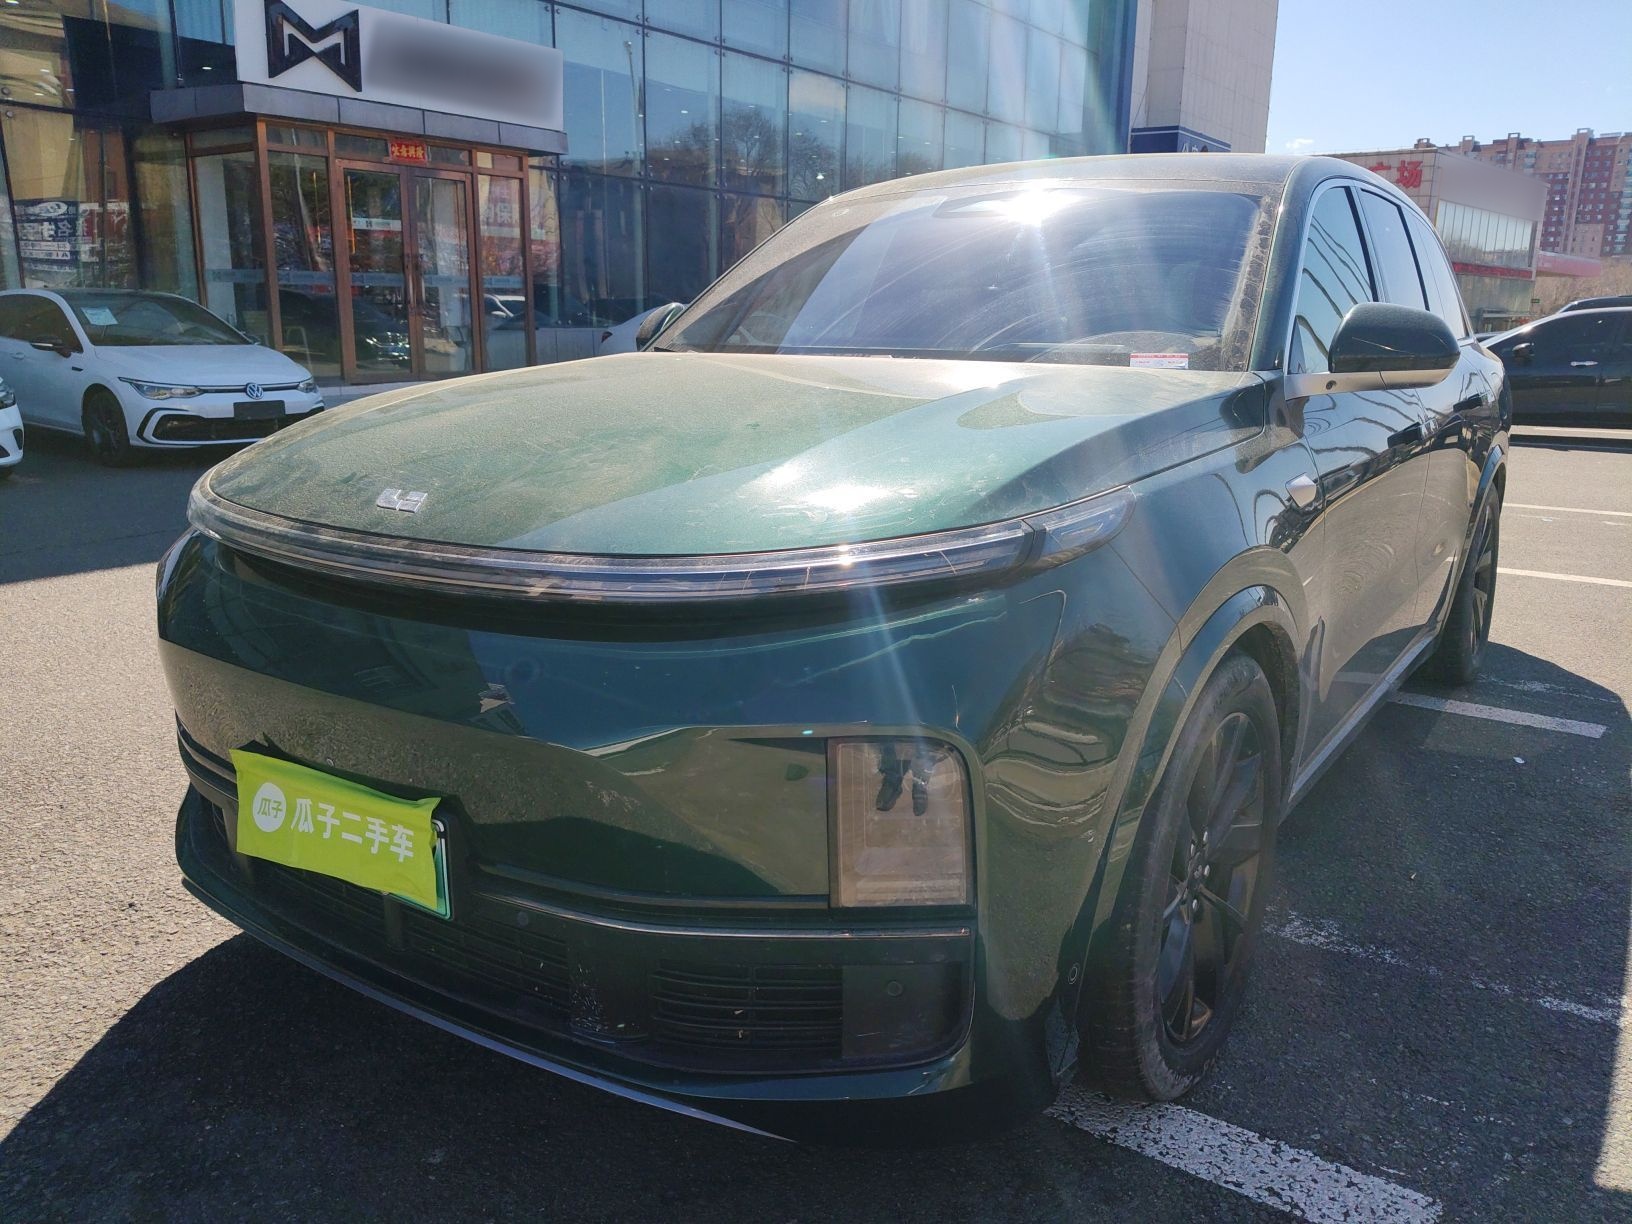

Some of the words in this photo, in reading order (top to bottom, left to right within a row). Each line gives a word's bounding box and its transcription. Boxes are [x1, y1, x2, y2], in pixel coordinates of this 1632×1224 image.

[257, 798, 283, 818] 瓜子
[291, 798, 414, 862] 瓜子二手车
